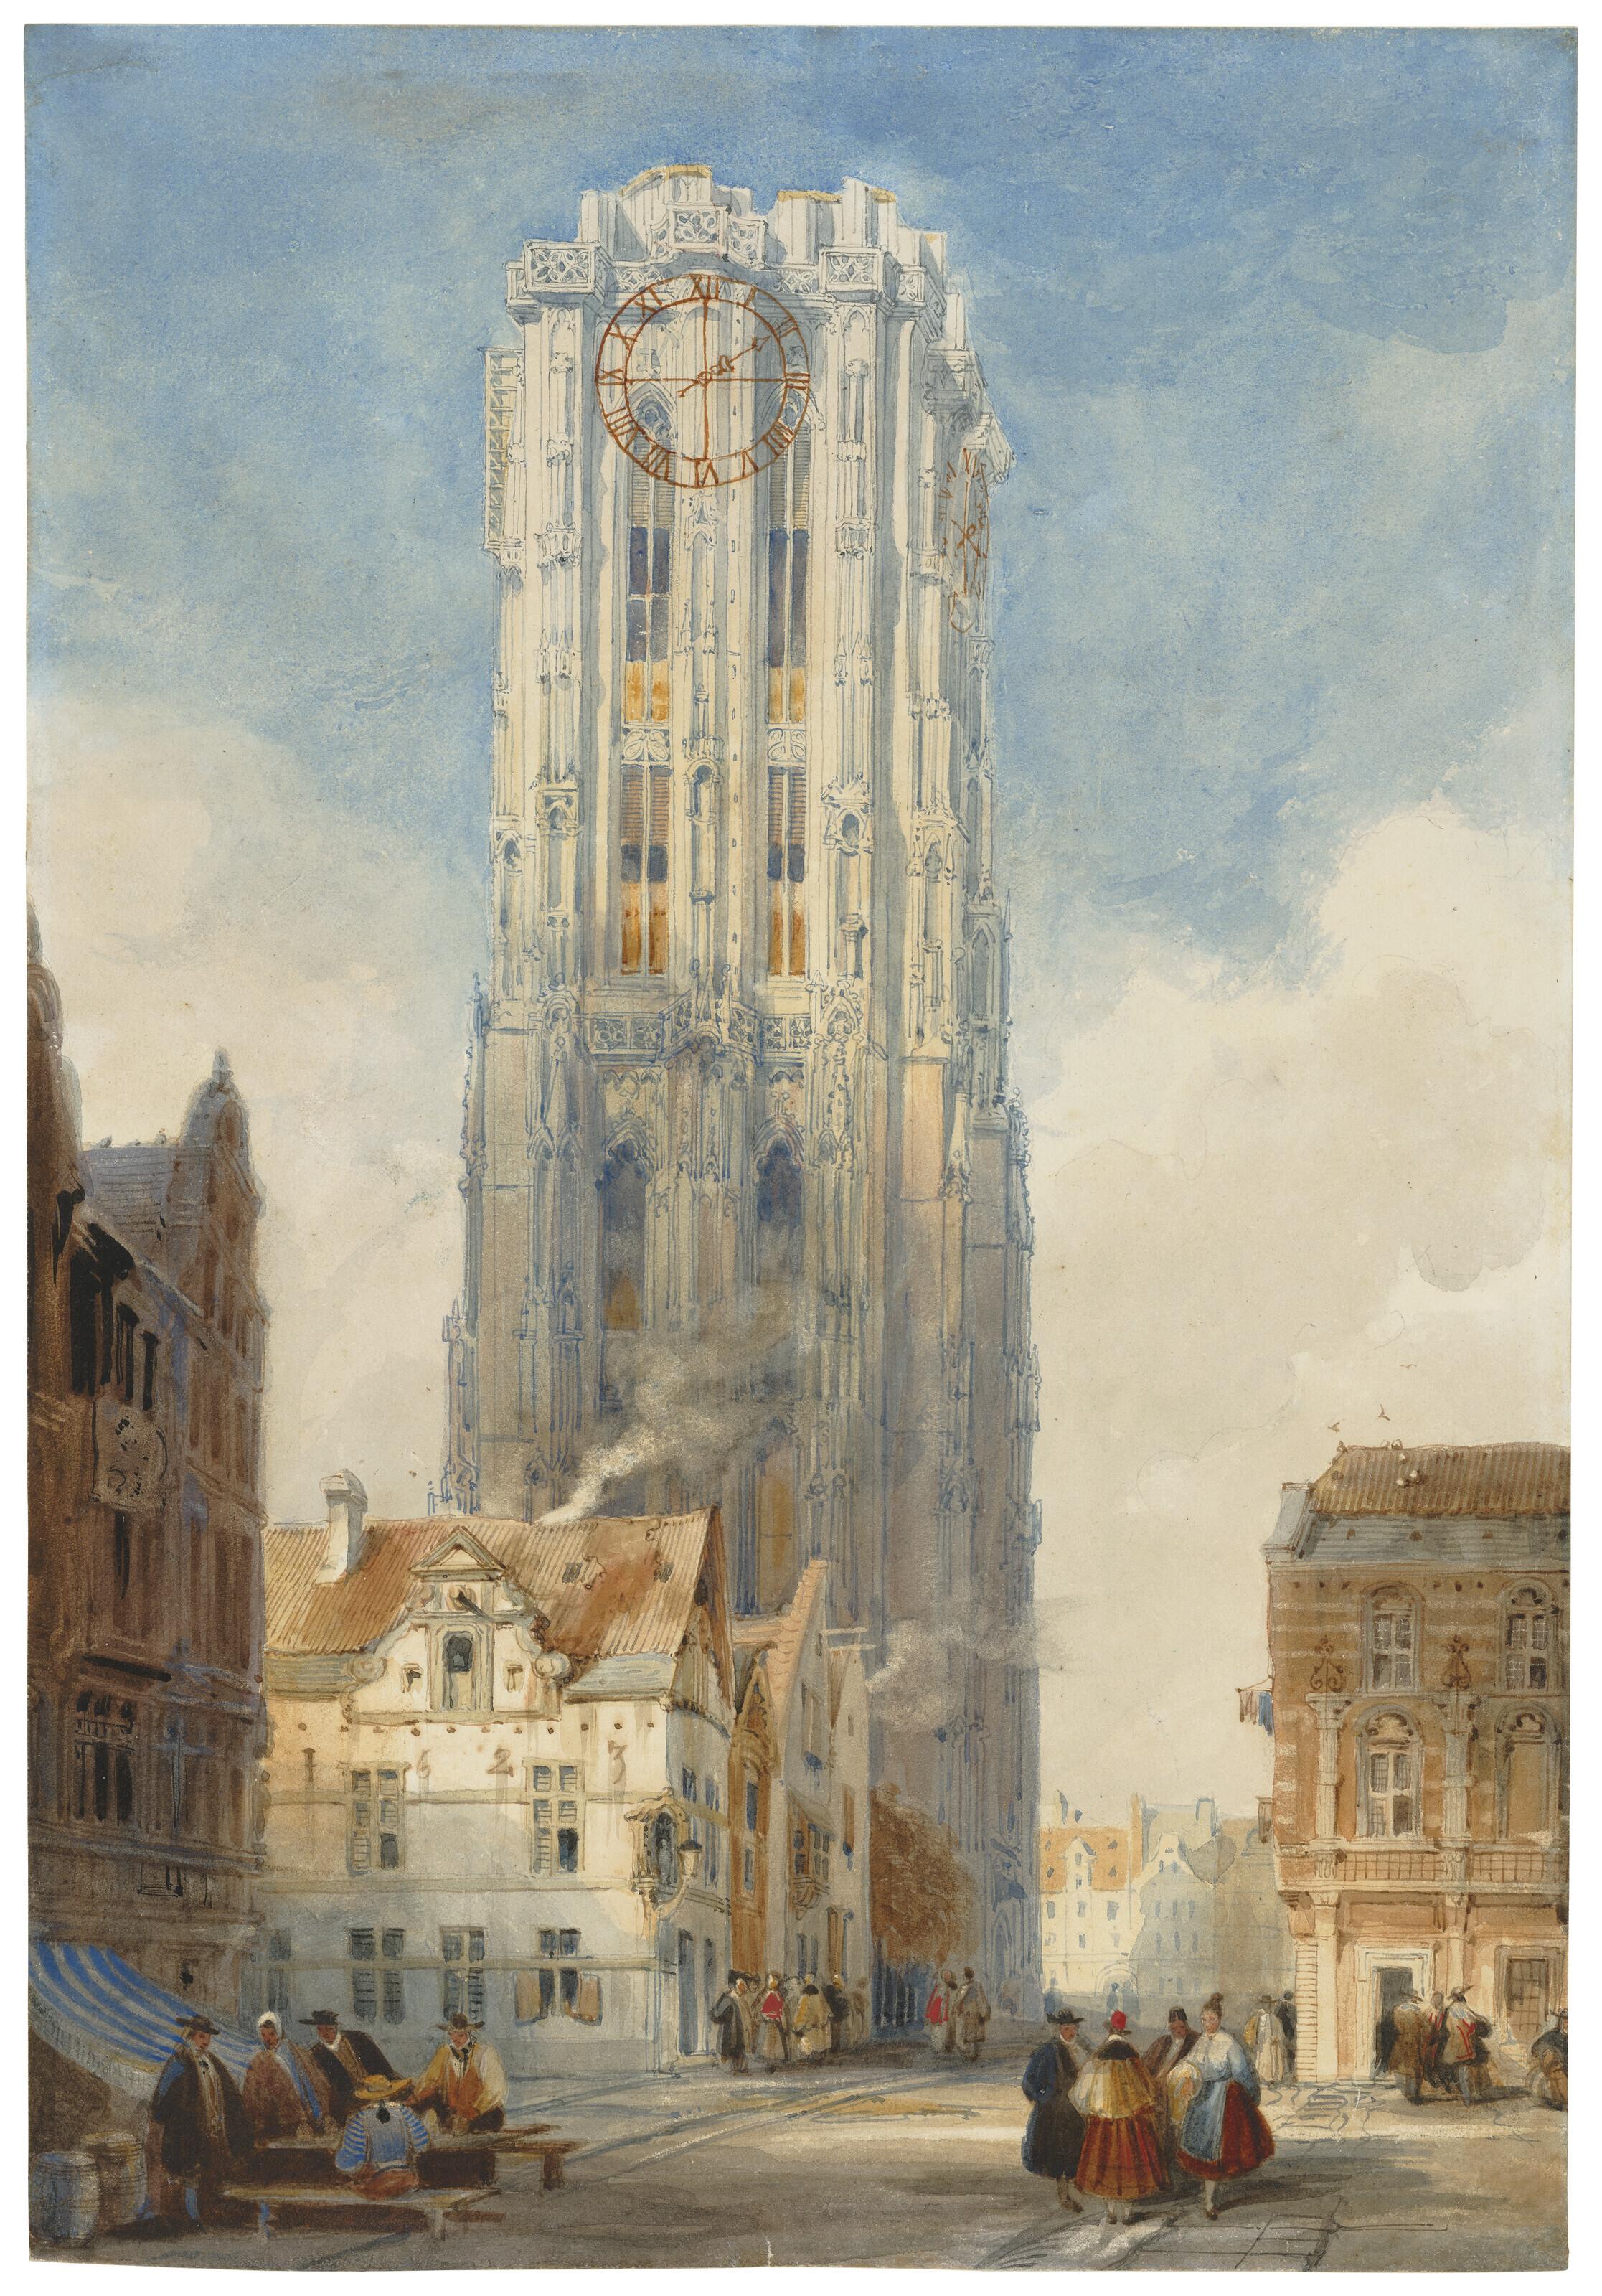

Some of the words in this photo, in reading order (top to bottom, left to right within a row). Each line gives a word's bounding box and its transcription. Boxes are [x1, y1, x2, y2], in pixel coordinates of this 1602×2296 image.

[689, 274, 720, 298] XII
[633, 287, 663, 321] XI
[608, 323, 637, 350] X
[786, 372, 811, 390] III
[486, 1746, 514, 1778] 2
[607, 1739, 628, 1784] 3
